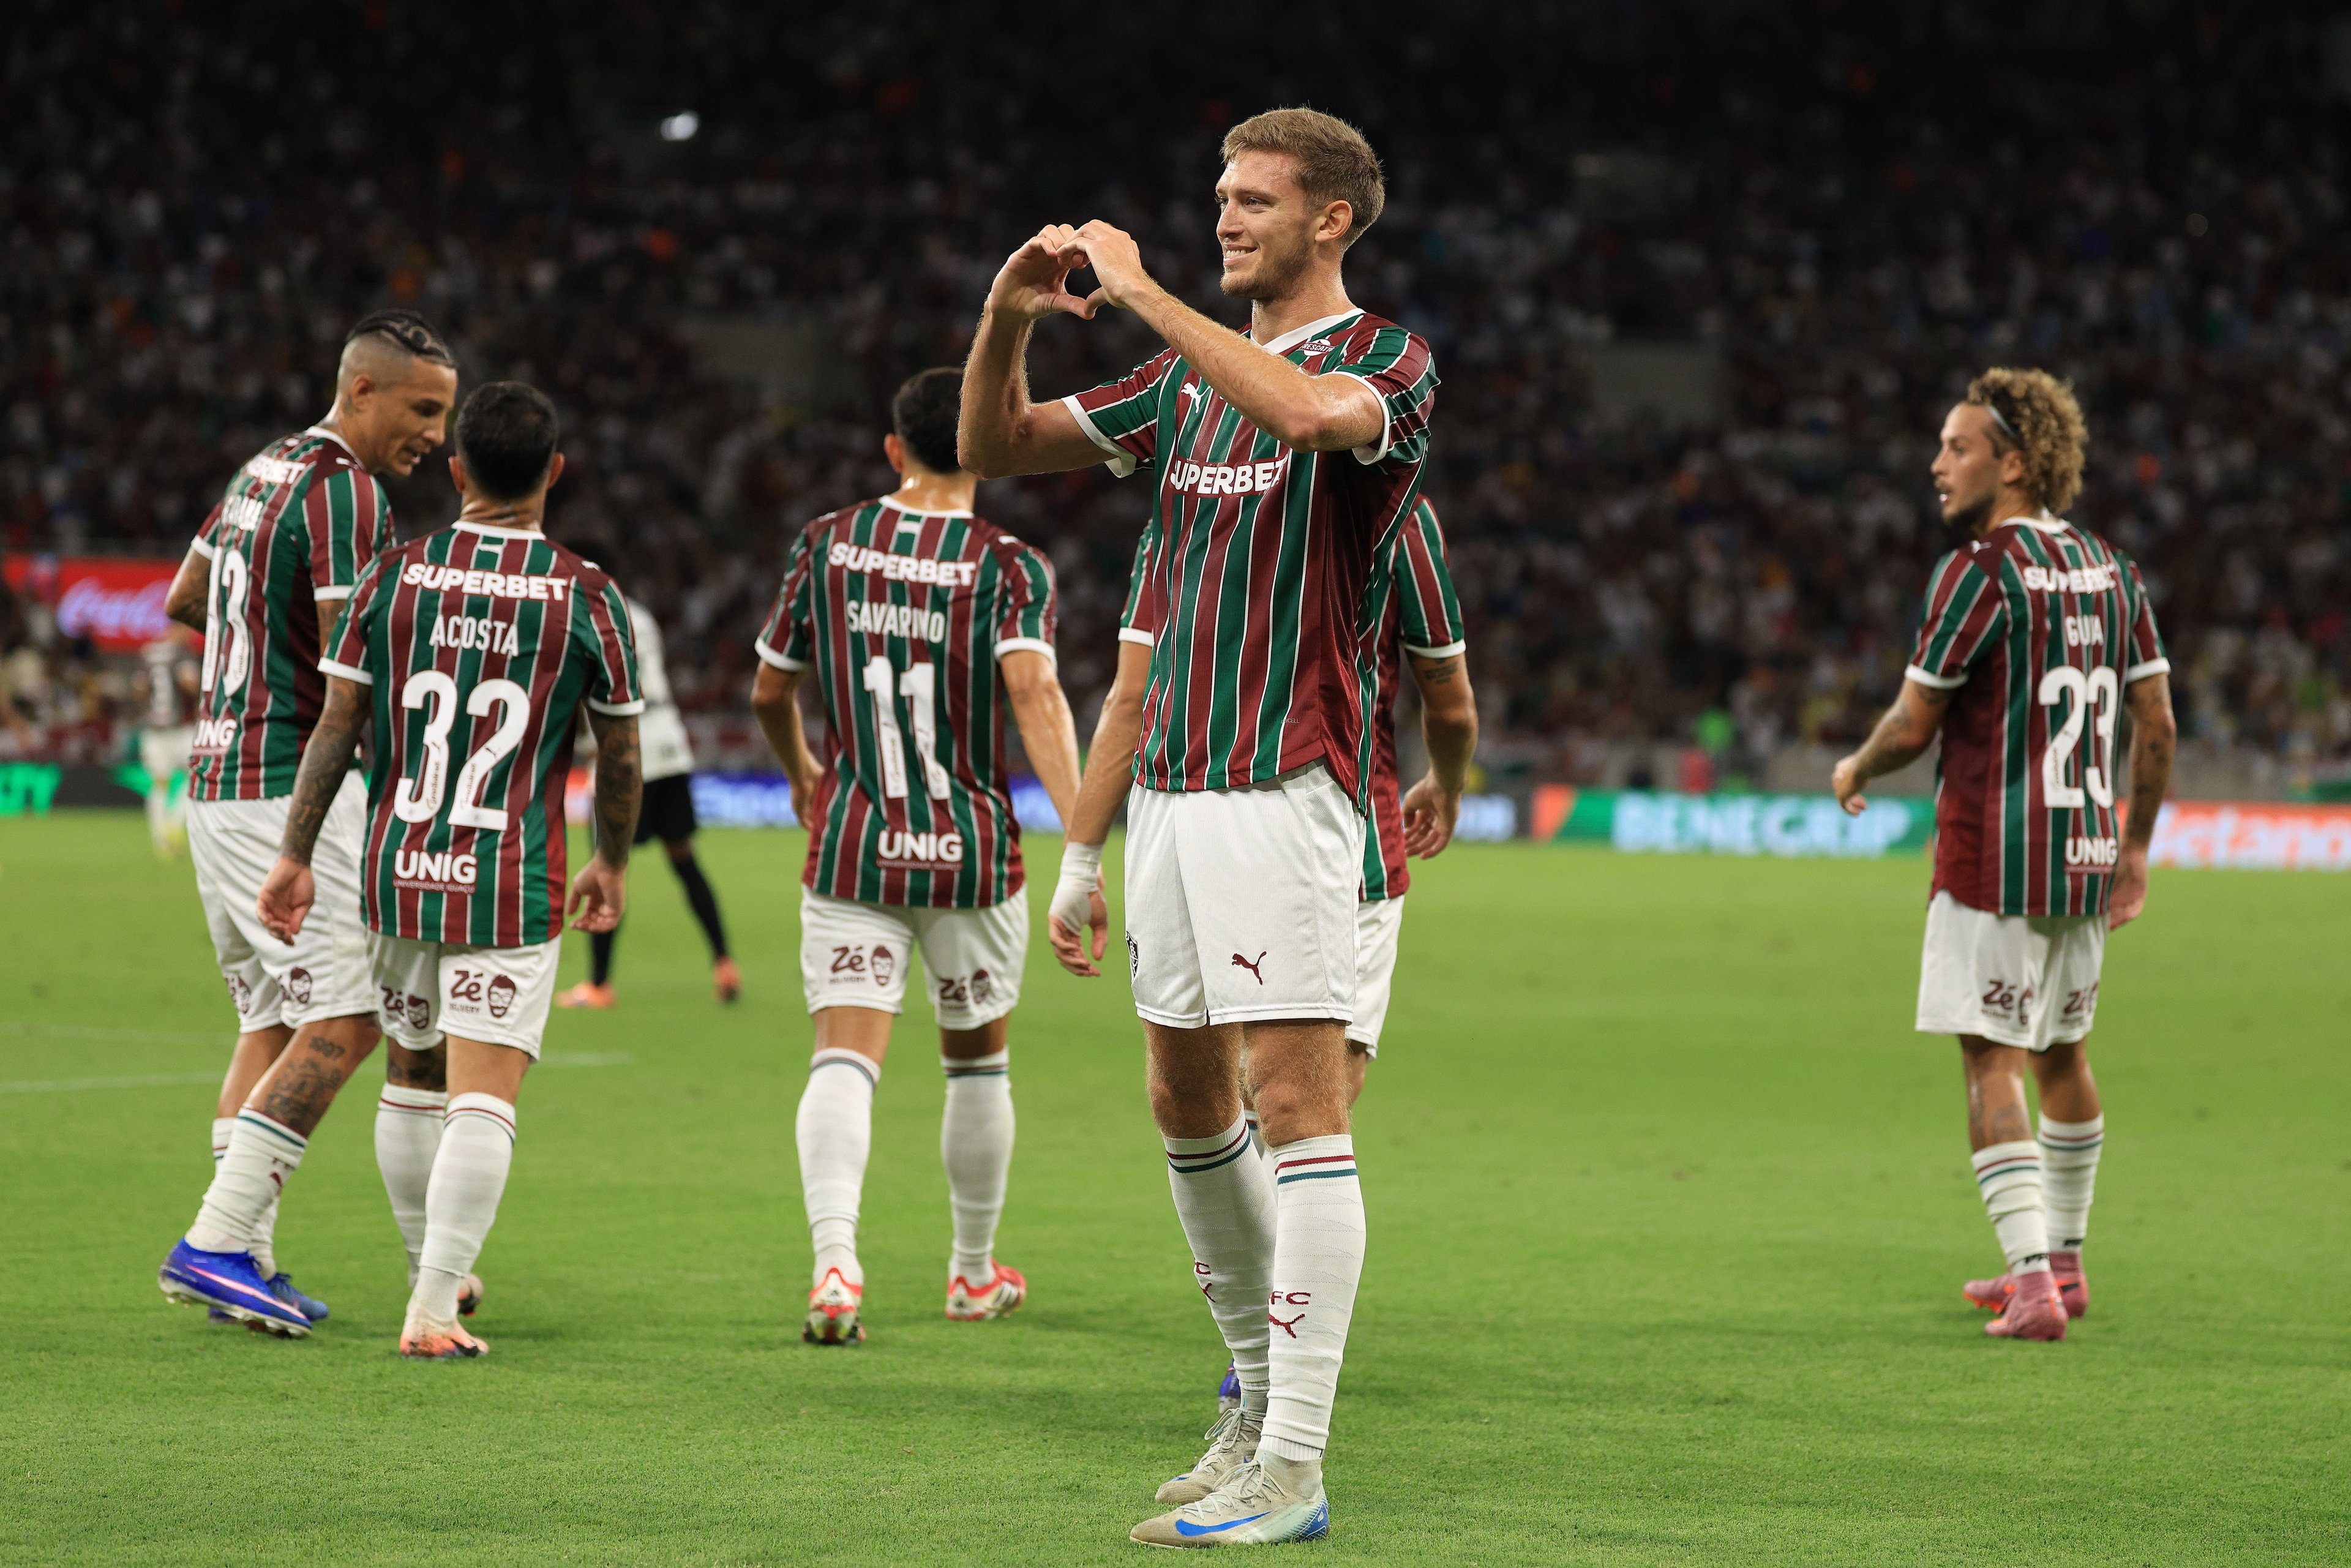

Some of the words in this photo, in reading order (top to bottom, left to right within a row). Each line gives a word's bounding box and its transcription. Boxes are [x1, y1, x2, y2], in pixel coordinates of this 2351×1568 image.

[402, 563, 568, 601] SUPERBET
[828, 541, 977, 587] SUPERBET
[201, 546, 253, 699] 13
[429, 613, 520, 657] ACOSTA
[847, 599, 945, 643] SAVARINO
[2065, 615, 2104, 647] GUA
[863, 655, 951, 800] 11
[2038, 666, 2118, 809] 23
[393, 669, 531, 831] 32
[394, 849, 477, 884] UNIG
[877, 830, 963, 862] UNIG
[2065, 836, 2118, 866] UNIG
[831, 945, 866, 973] Zé
[451, 970, 482, 1002] Zé
